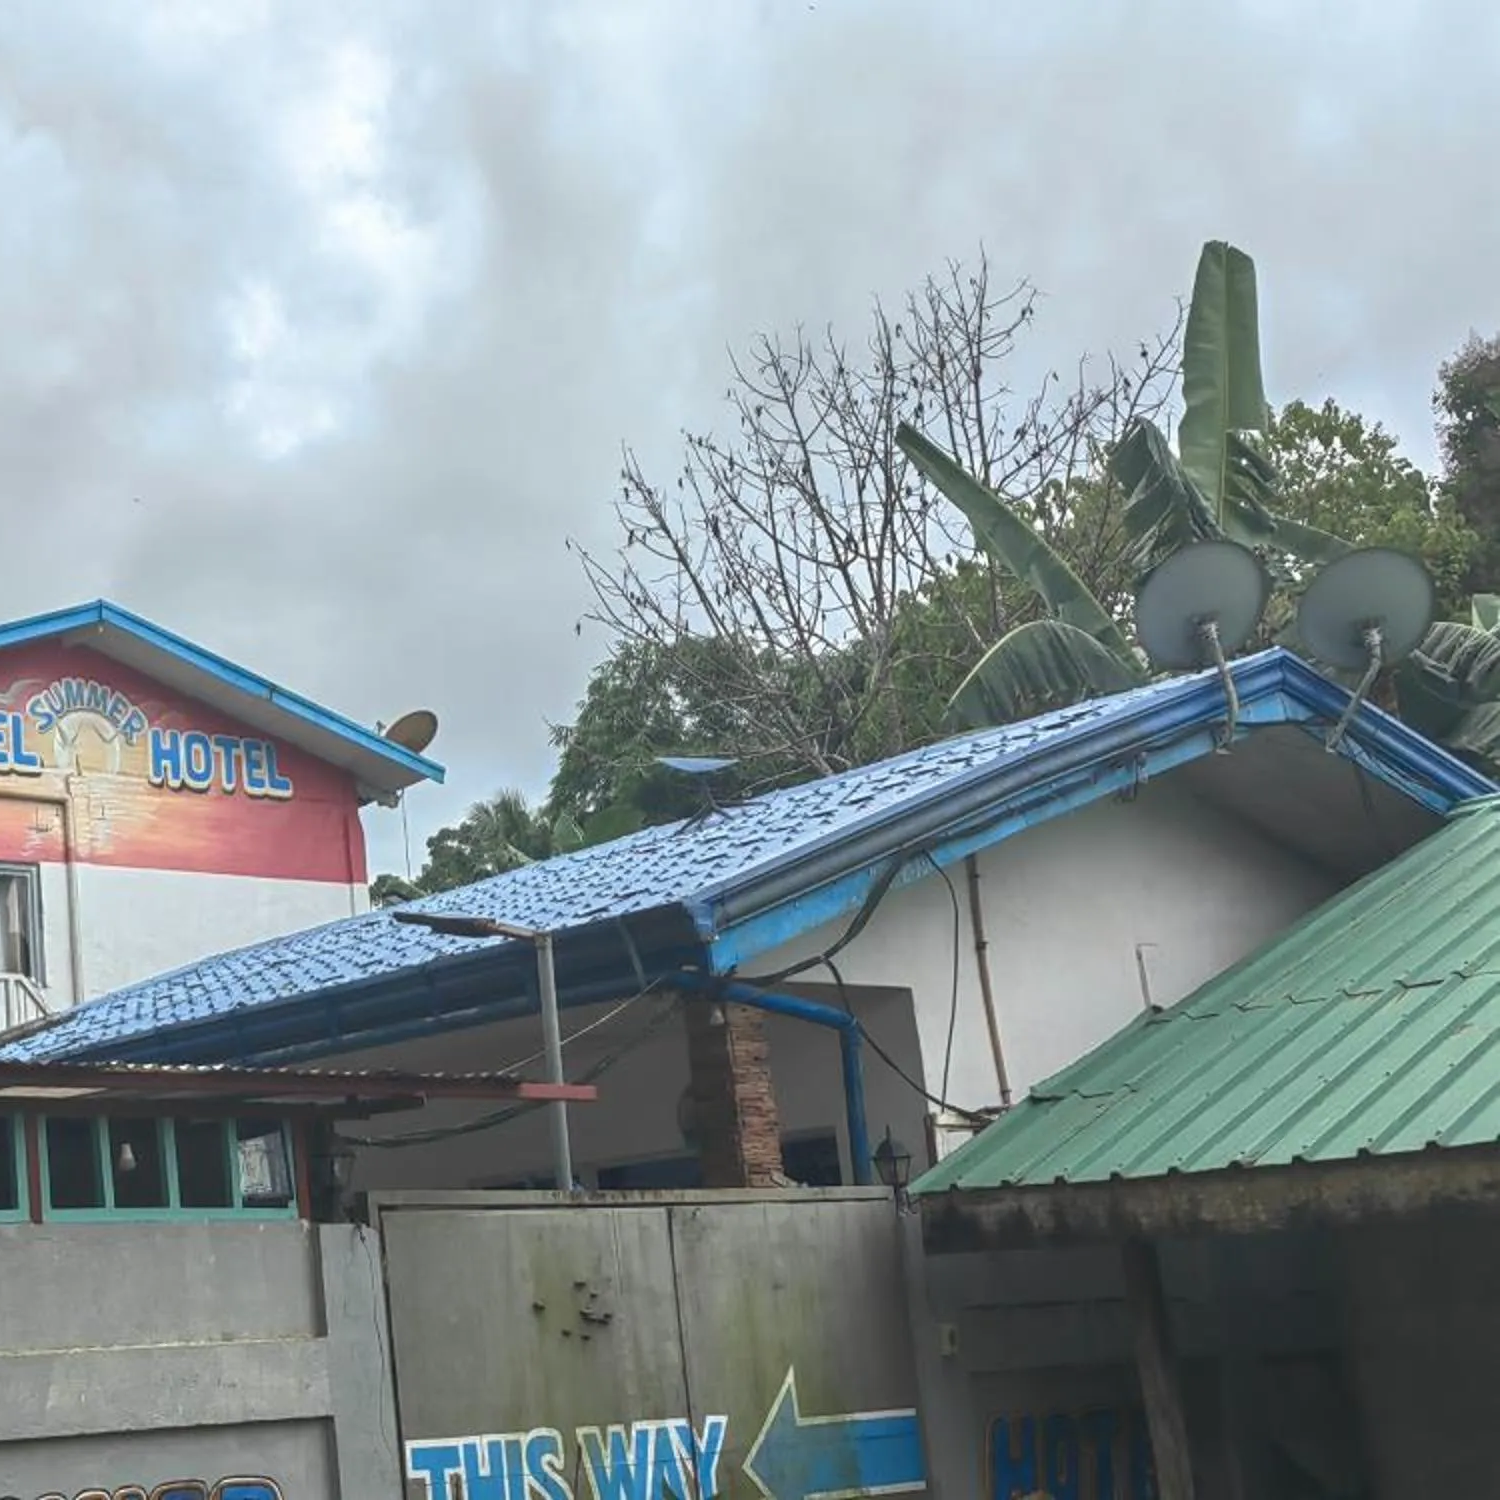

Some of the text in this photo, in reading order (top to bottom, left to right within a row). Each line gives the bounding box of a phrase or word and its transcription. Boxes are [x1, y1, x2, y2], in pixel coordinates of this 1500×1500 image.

[26, 677, 149, 746] SUMMER
[148, 727, 293, 798] HOTEL
[405, 1415, 727, 1500] THIS WAY
